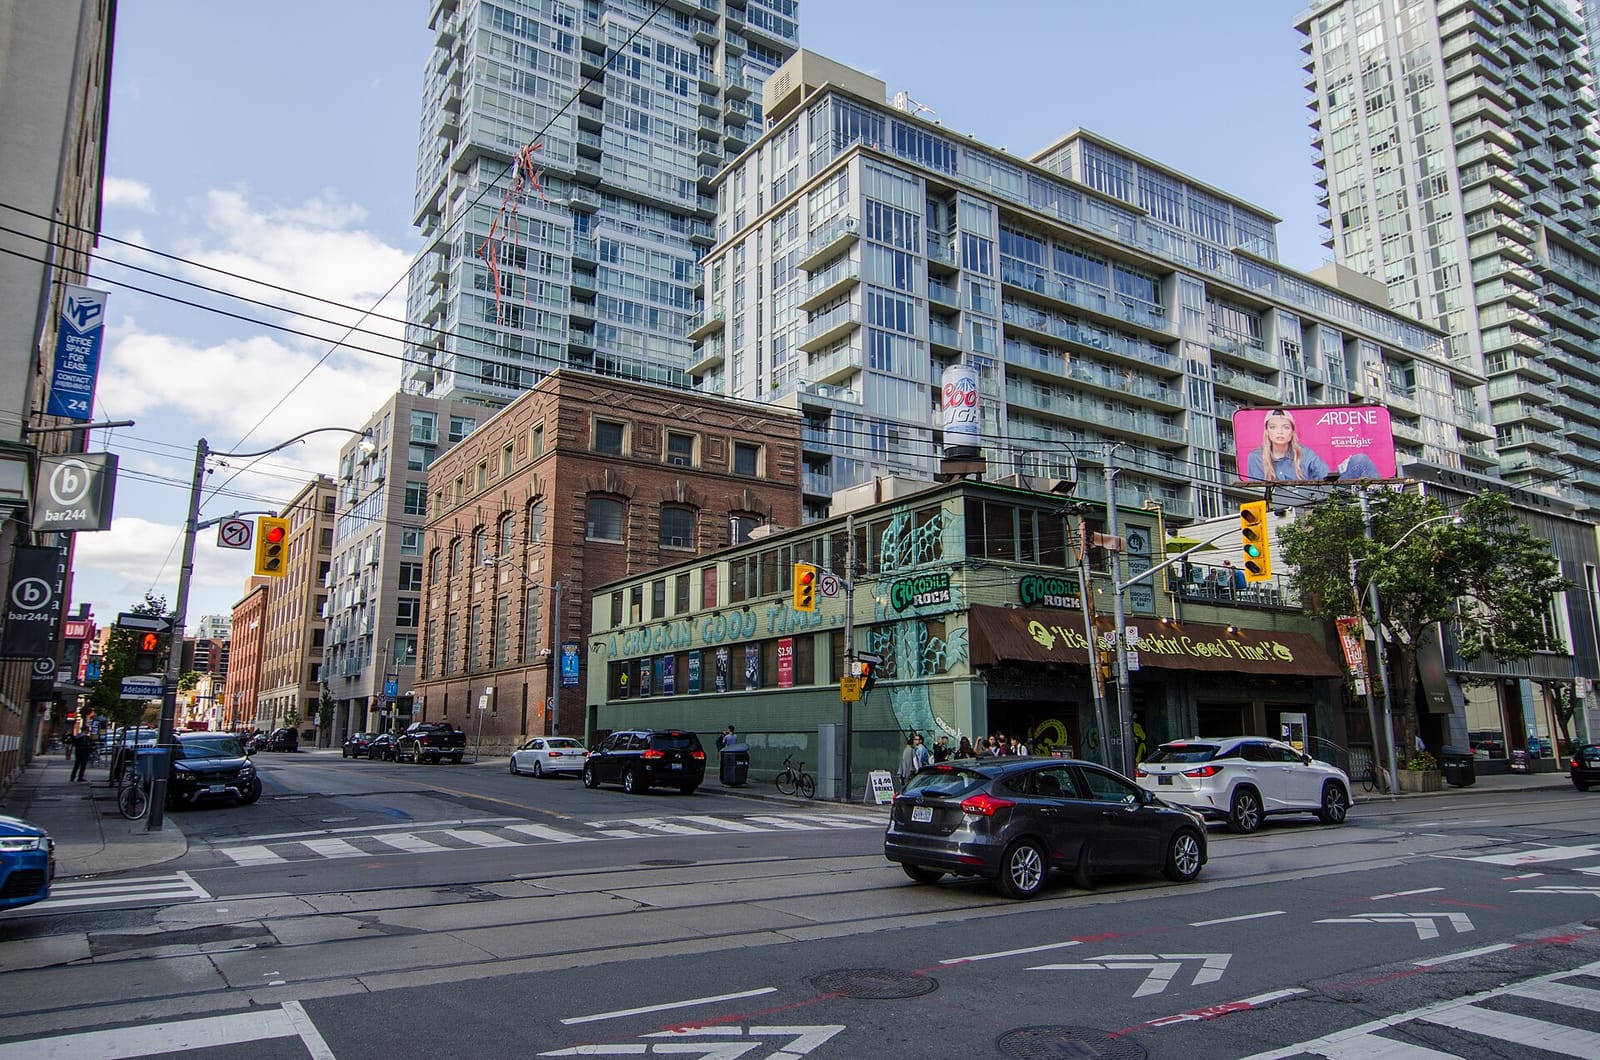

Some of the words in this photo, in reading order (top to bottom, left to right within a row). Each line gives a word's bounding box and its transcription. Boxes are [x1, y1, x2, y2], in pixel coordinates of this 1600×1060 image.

[66, 335, 93, 347] OFFICE
[65, 344, 92, 355] SPACE
[69, 353, 85, 363] FOR
[64, 361, 87, 372] LEASE
[57, 373, 90, 384] CONTACT
[67, 399, 88, 411] 24
[1316, 411, 1377, 426] ARDENE
[1331, 434, 1373, 449] starlight
[45, 510, 87, 521] bar244
[913, 590, 950, 606] ROCK
[1044, 595, 1081, 609] ROCK
[8, 611, 49, 622] bar244
[607, 635, 617, 658] A
[623, 619, 698, 656] CROCKIN'
[702, 608, 757, 644] GOOD
[1181, 636, 1232, 658] Good
[123, 684, 150, 694] Adelaide
